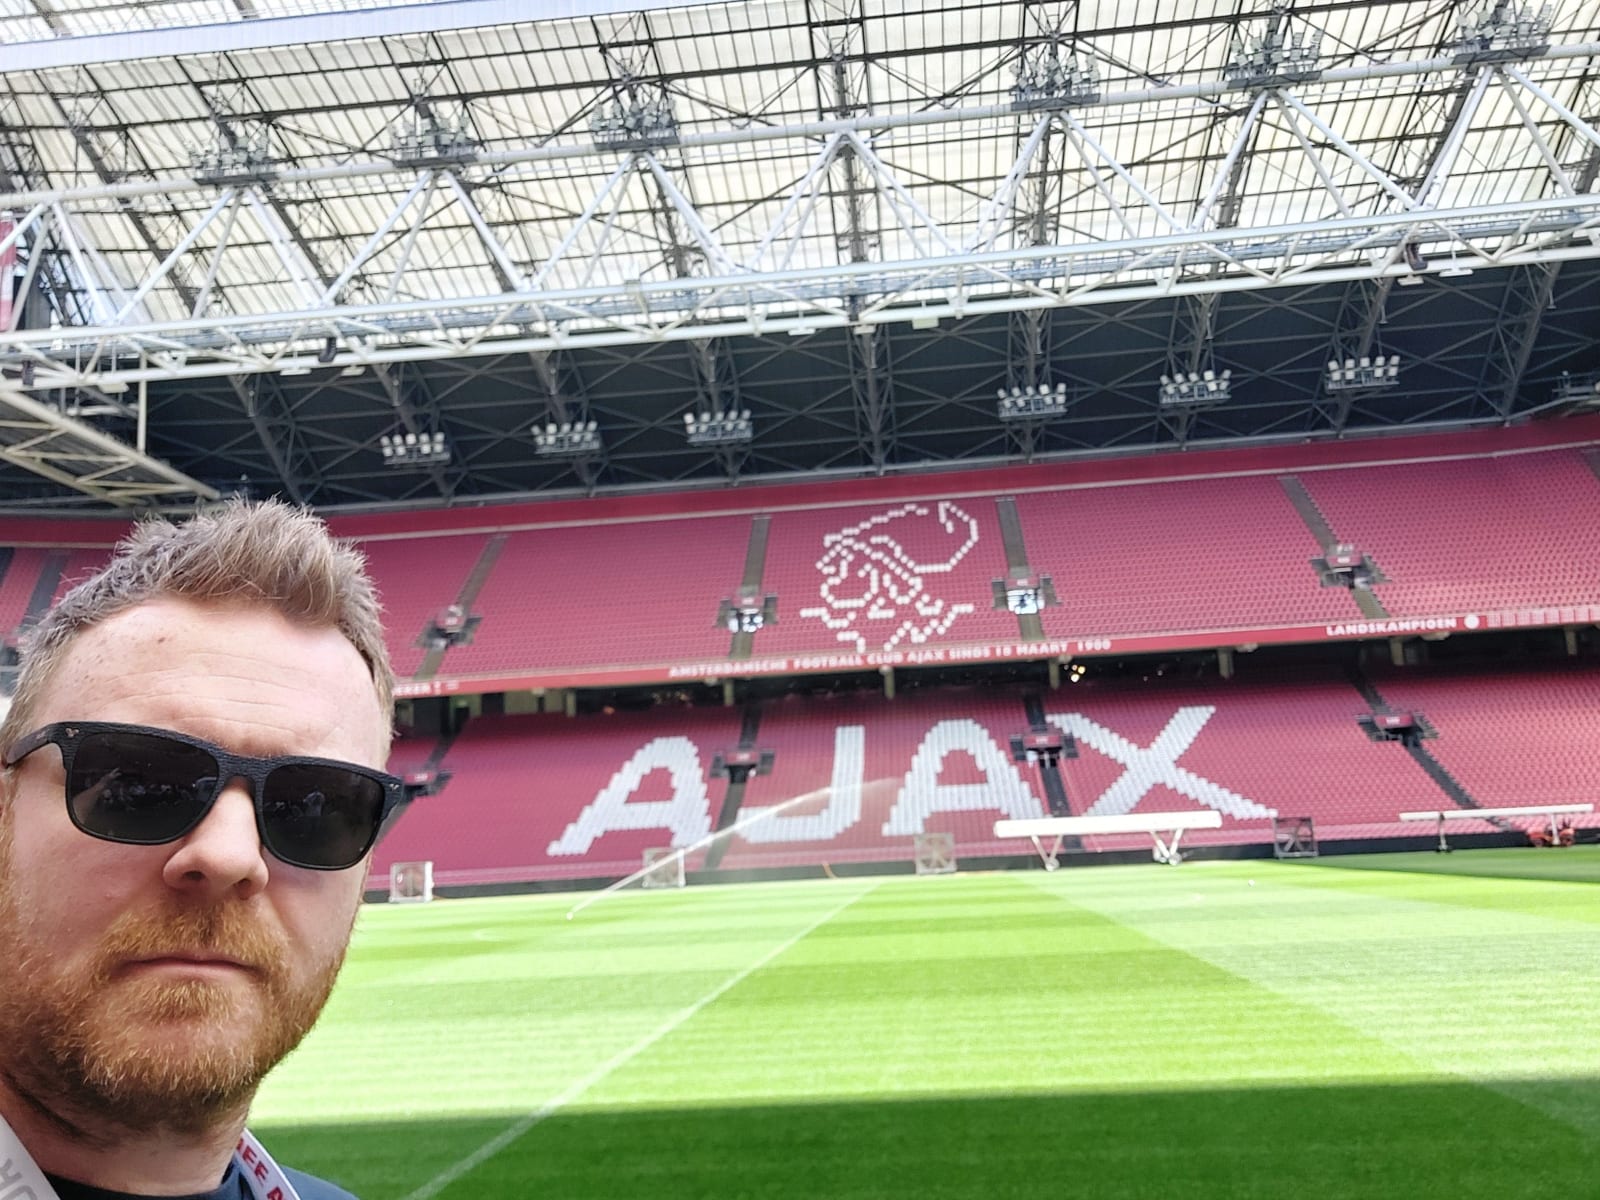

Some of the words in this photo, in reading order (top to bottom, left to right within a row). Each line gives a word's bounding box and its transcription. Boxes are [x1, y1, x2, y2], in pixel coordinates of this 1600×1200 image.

[1327, 618, 1457, 636] LANDSKAMPIOEN
[669, 660, 787, 678] AMSTERDAMSCHE
[793, 654, 863, 669] FOOTBALL
[867, 650, 903, 665] CLUB
[907, 650, 944, 664] AJAX
[949, 647, 990, 660] SINDS
[1017, 641, 1068, 656] MAART
[1076, 638, 1111, 651] 1900
[546, 704, 1278, 856] AJAX
